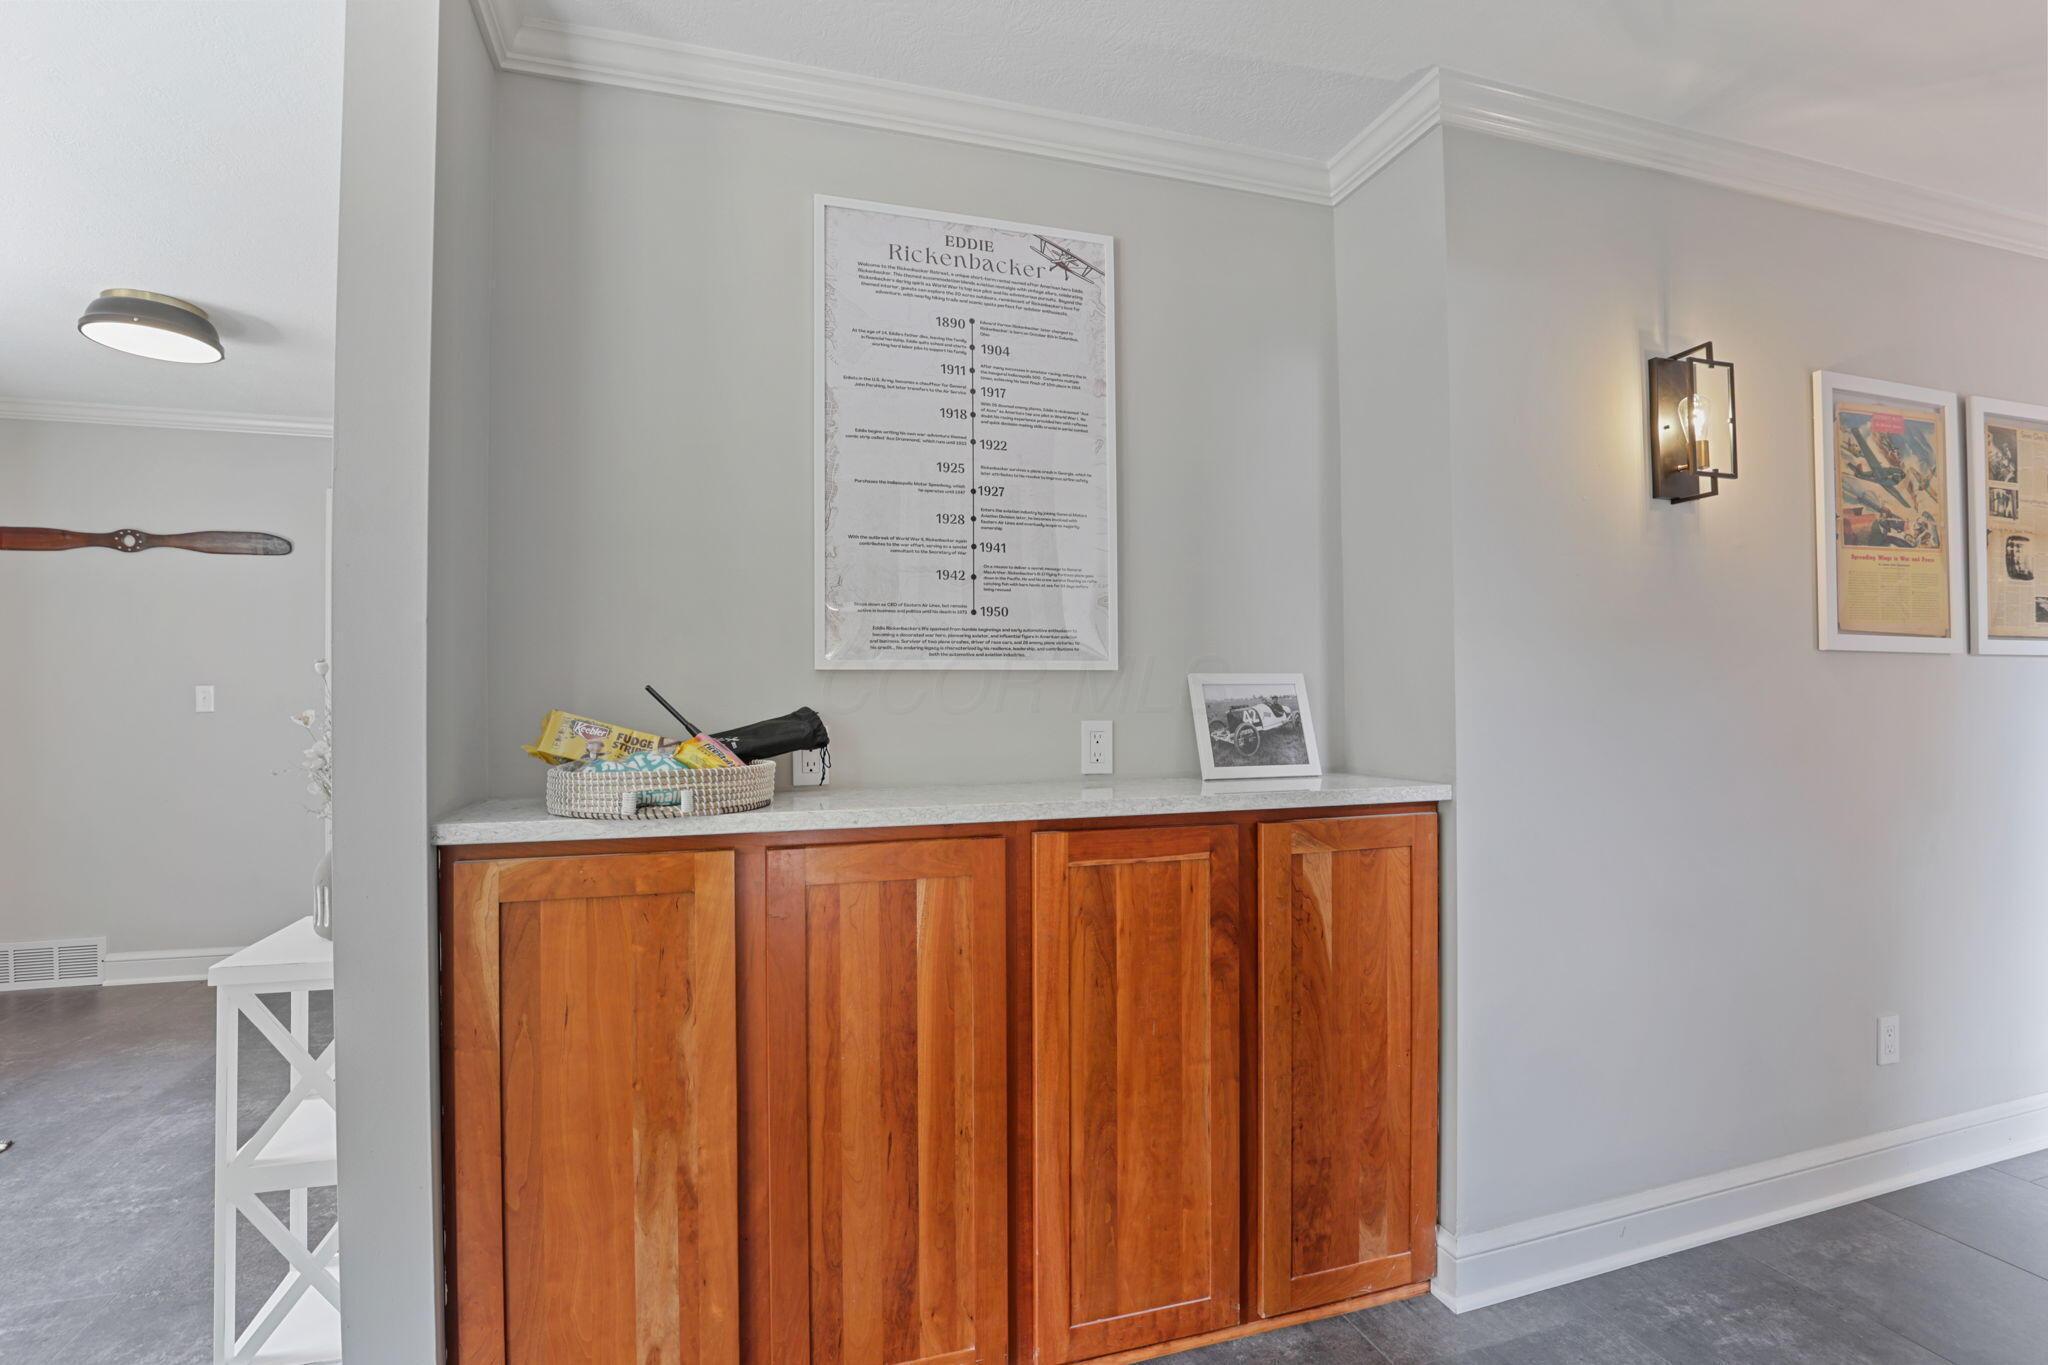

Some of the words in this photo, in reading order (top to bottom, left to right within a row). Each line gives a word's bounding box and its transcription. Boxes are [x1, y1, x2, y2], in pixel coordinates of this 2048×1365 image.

[945, 234, 993, 252] EDDIE
[889, 242, 1045, 278] Rickenbacker
[935, 316, 965, 328] 1890
[981, 343, 1009, 356] 1904
[940, 363, 965, 375] 1911
[980, 386, 1006, 398] 1917
[939, 407, 967, 419] 1918
[979, 439, 1007, 451] 1922
[936, 461, 964, 473] 1925
[977, 485, 1004, 497] 1927
[936, 512, 964, 524] 1928
[979, 541, 1005, 553] 1941
[936, 569, 965, 580] 1942
[980, 605, 1008, 616] 1950
[1242, 709, 1260, 724] 42
[574, 721, 607, 738] Keebler
[616, 732, 655, 749] FUDGE
